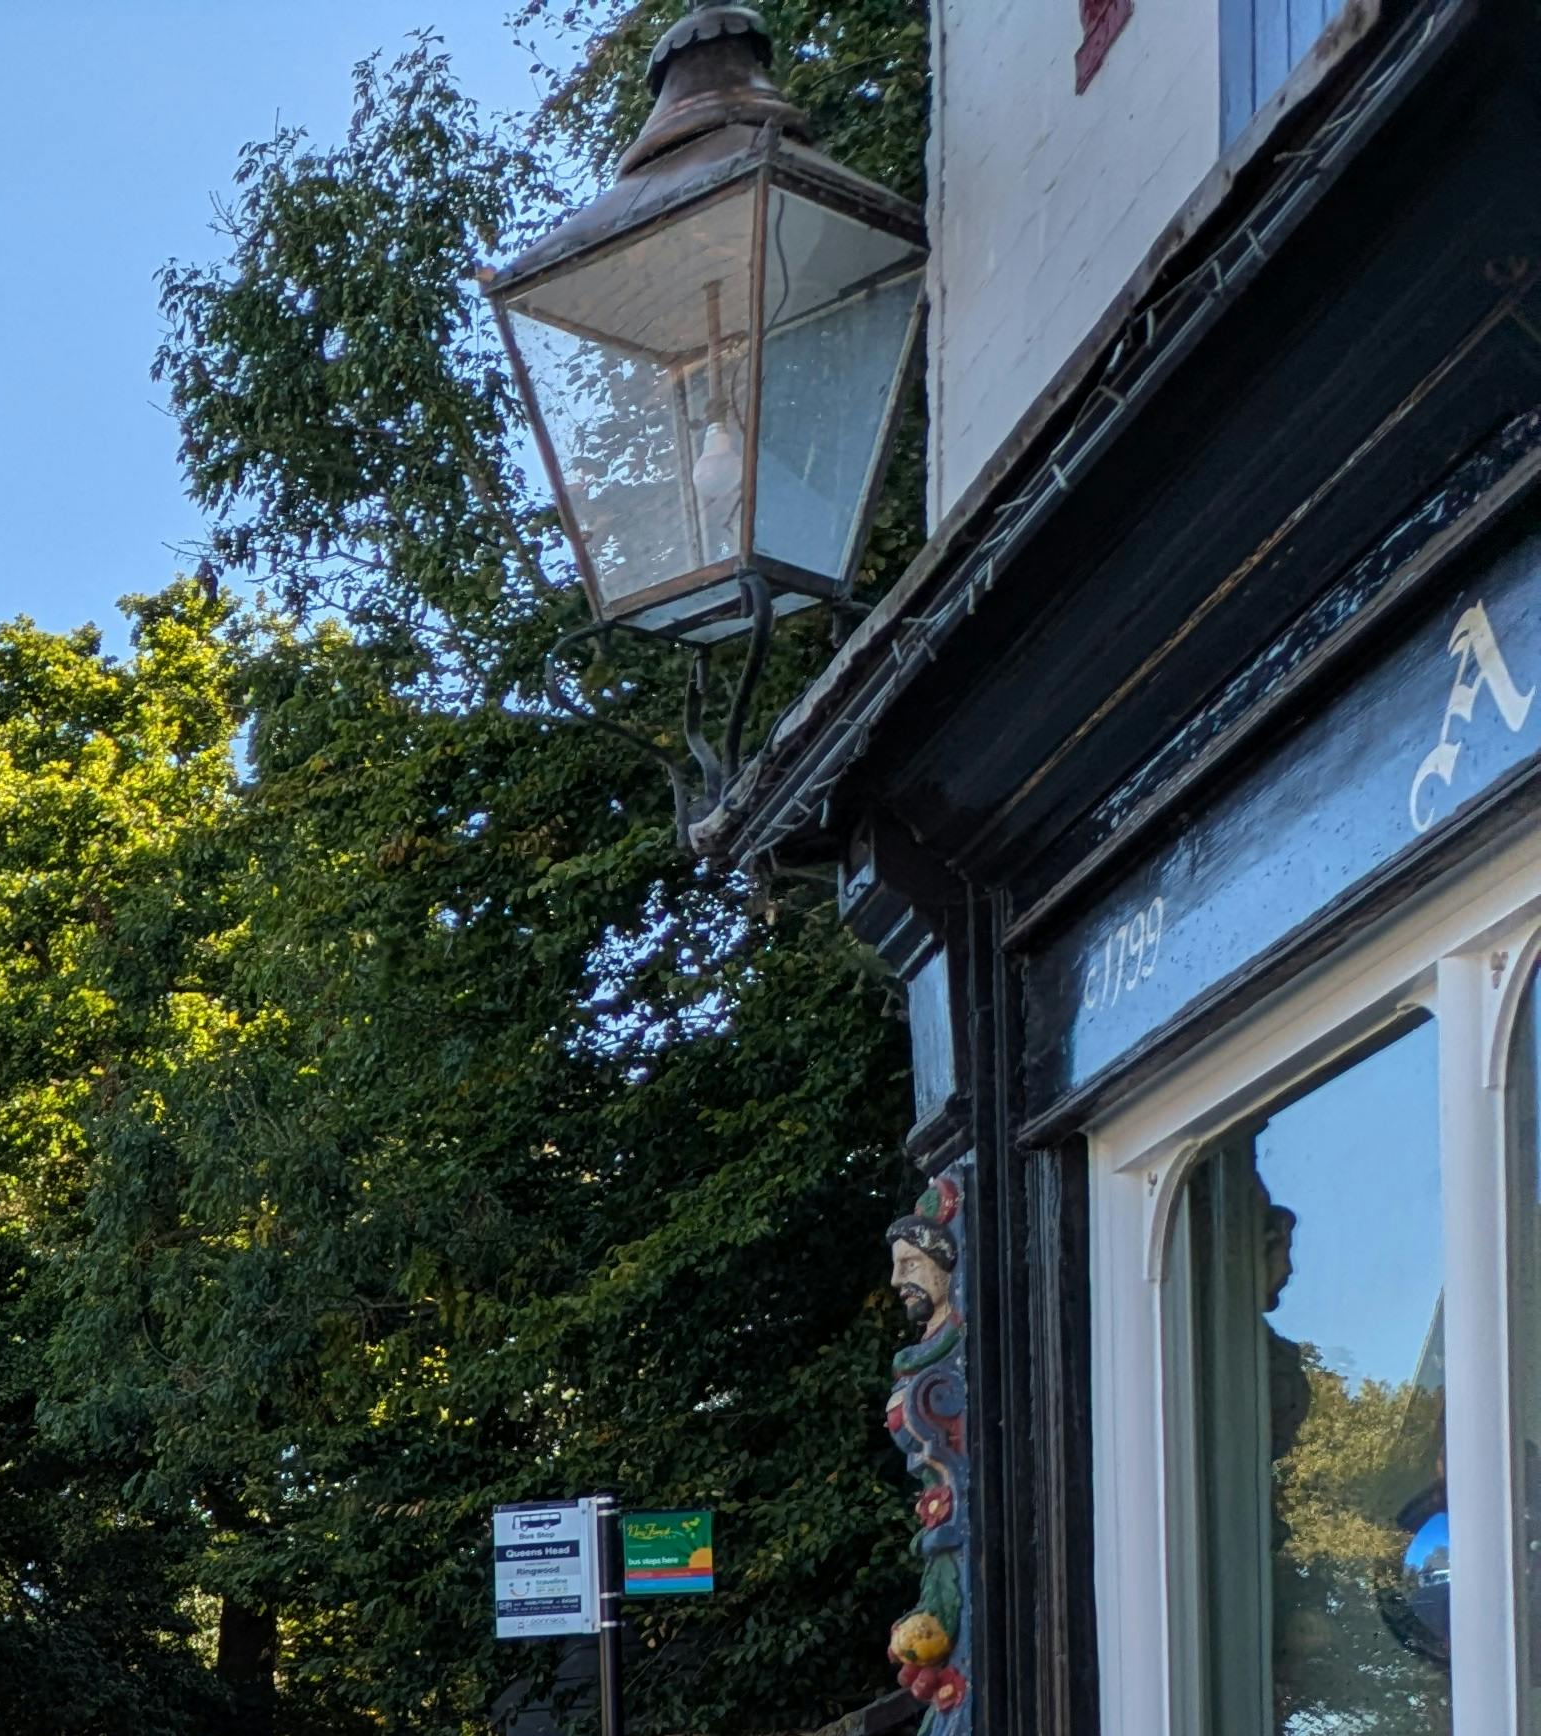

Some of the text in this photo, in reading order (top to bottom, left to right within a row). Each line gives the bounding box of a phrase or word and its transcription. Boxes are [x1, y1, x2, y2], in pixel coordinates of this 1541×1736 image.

[1409, 598, 1537, 834] A
[537, 1531, 555, 1539] Stop
[505, 1546, 570, 1559] Queens Head
[628, 1556, 679, 1566] bus stops here
[516, 1566, 560, 1577] Ringwood
